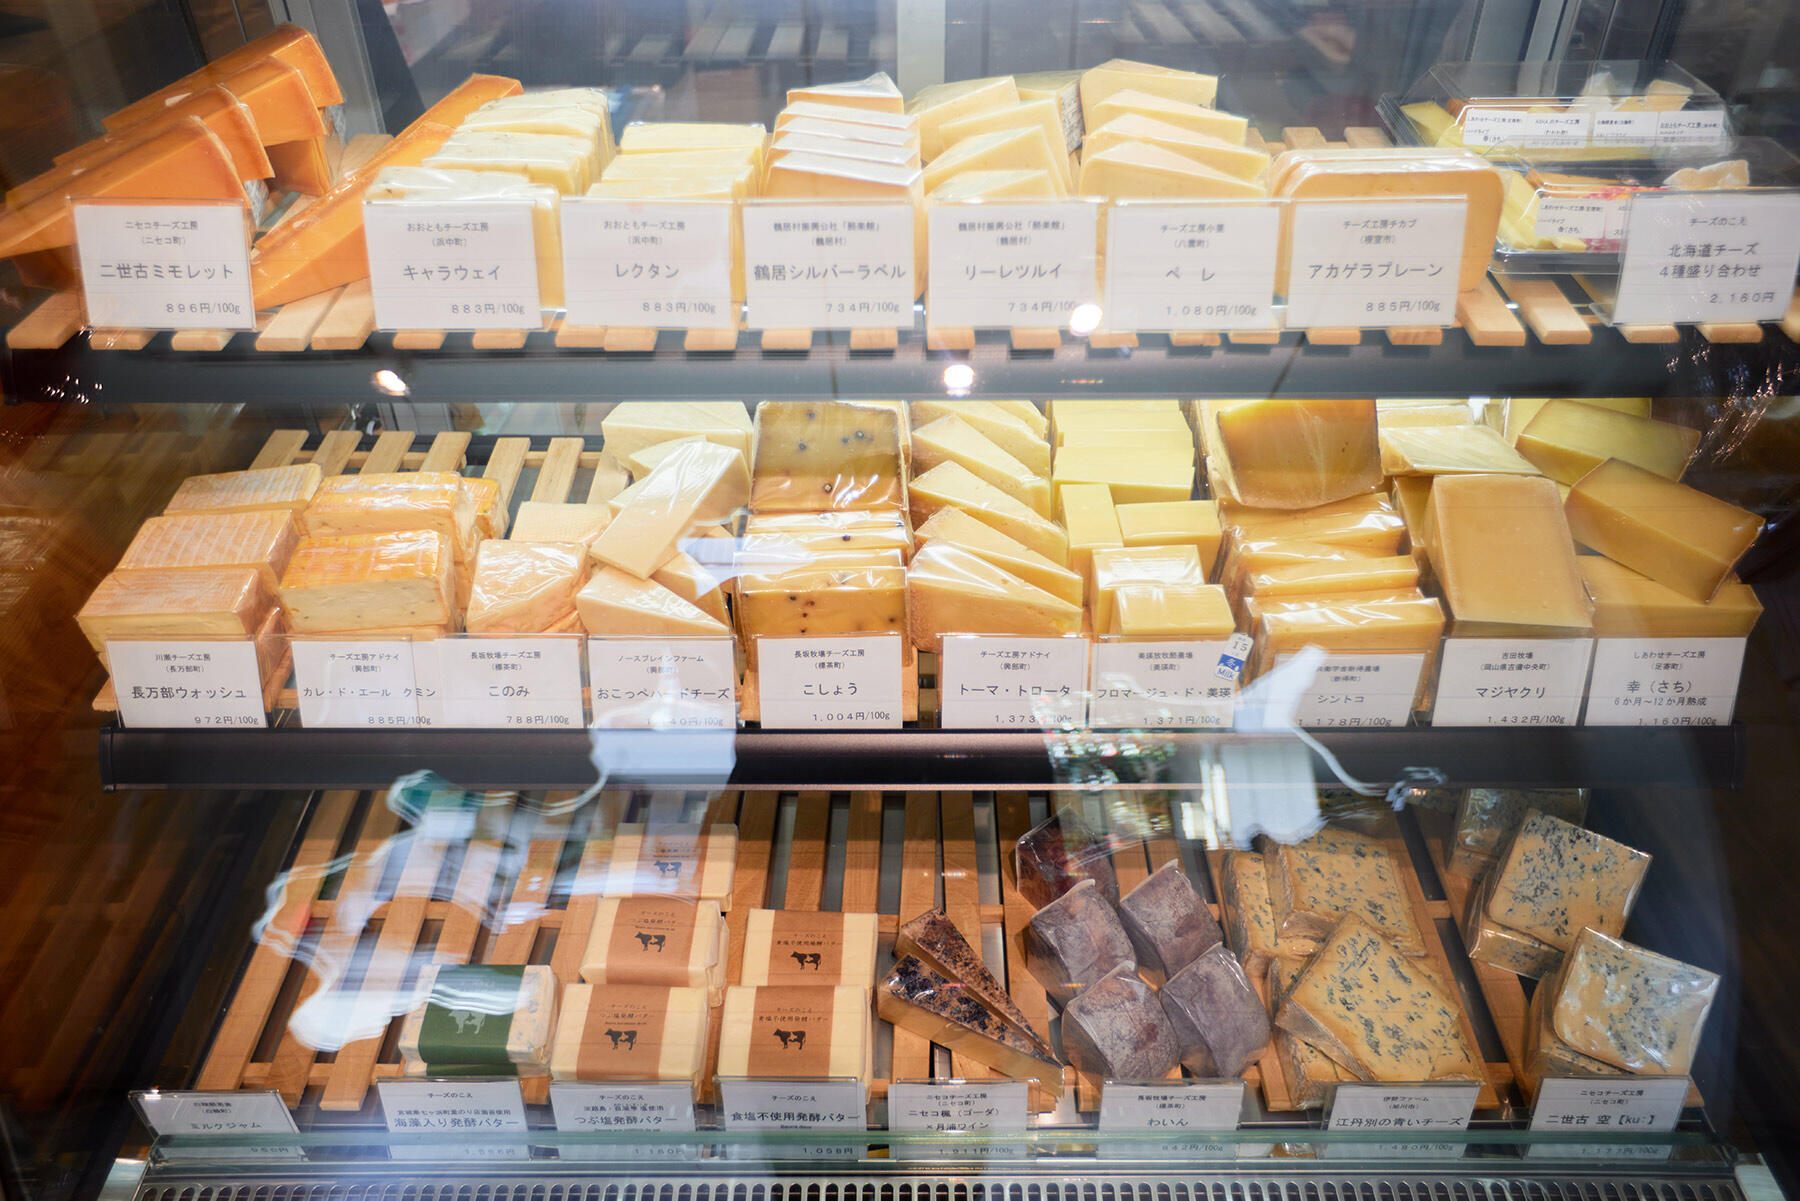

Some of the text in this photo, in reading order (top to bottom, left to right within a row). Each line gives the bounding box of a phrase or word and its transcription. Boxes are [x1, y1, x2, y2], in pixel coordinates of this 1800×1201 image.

[125, 220, 199, 231] ニセコチーズ工房
[407, 221, 489, 232] おおともチーズ工房
[603, 220, 686, 231] おおともチーズ工房
[1689, 216, 1748, 227] チーズのこえ
[142, 236, 186, 246] （ニセコ町）
[1668, 241, 1760, 259] 北海道チーズ
[100, 263, 233, 280] 二世古ミモレット
[402, 264, 501, 281] キャラウェイ
[615, 263, 680, 280] レクタン
[753, 263, 907, 282] 鶴居シルバーラベル
[965, 263, 1064, 281] リーレツルイ
[1308, 260, 1444, 280] アカゲラプレーン
[1658, 263, 1762, 280] 4種盛り合わせ
[1709, 290, 1776, 304] 2,160円
[166, 302, 241, 315] 896円/100g
[451, 303, 526, 315] 883円/100g
[642, 302, 717, 315] 883円/100g
[825, 301, 901, 314] 734円/100g
[1007, 300, 1080, 313] 734円/100
[1166, 303, 1258, 317] 1,080円/100g
[1366, 300, 1441, 313] 885円/100g
[155, 652, 212, 662] 川瀬チーズ工房
[329, 652, 400, 662] チーズ工房アドナイ
[980, 650, 1051, 660] チーズ工房アドナイ
[1501, 651, 1534, 660] 吉田牧場
[1633, 650, 1707, 660] しあわせチーズ工房
[165, 664, 206, 674] （長万部町）
[1480, 663, 1552, 672] （岡山県吉備中央町）
[131, 685, 248, 700] 長万部ウォッシュ
[303, 686, 436, 698] カレ・ド・エール クミン
[488, 685, 531, 698] このみ
[803, 681, 859, 696] こしょう
[960, 682, 1071, 698] トーマ・トロータ
[1475, 685, 1547, 699] マジヤクリ
[1626, 679, 1694, 694] 幸（さち）
[1096, 687, 1232, 699] フロマージュ・ド・美瑛
[1317, 694, 1366, 704] シントコ
[194, 715, 260, 726] 972円/100g
[367, 715, 432, 726] 885円/100g
[506, 714, 570, 725] 788円/100g
[812, 710, 891, 722] 1,004円/100g
[1142, 715, 1222, 726] 1,371円/100g
[1487, 714, 1567, 725] 1,432円/100g
[427, 1091, 474, 1100] チーズのこえ
[599, 1093, 646, 1102] チーズのこえ
[770, 1094, 818, 1103] チーズのこえ
[926, 1092, 988, 1100] ニセコチーズ工房
[1579, 1089, 1645, 1097] ニセコチーズ工房
[393, 1117, 521, 1129] 海藻入り発酵バター
[574, 1115, 678, 1126] つぶ塩発酵バター
[730, 1111, 861, 1123] 食塩不使用発酵バター
[1146, 1117, 1190, 1128] わいん
[1335, 1116, 1465, 1128] 江丹別の青いチーズ
[1545, 1114, 1590, 1126] 二世古
[190, 1121, 264, 1130] ミルクジャム
